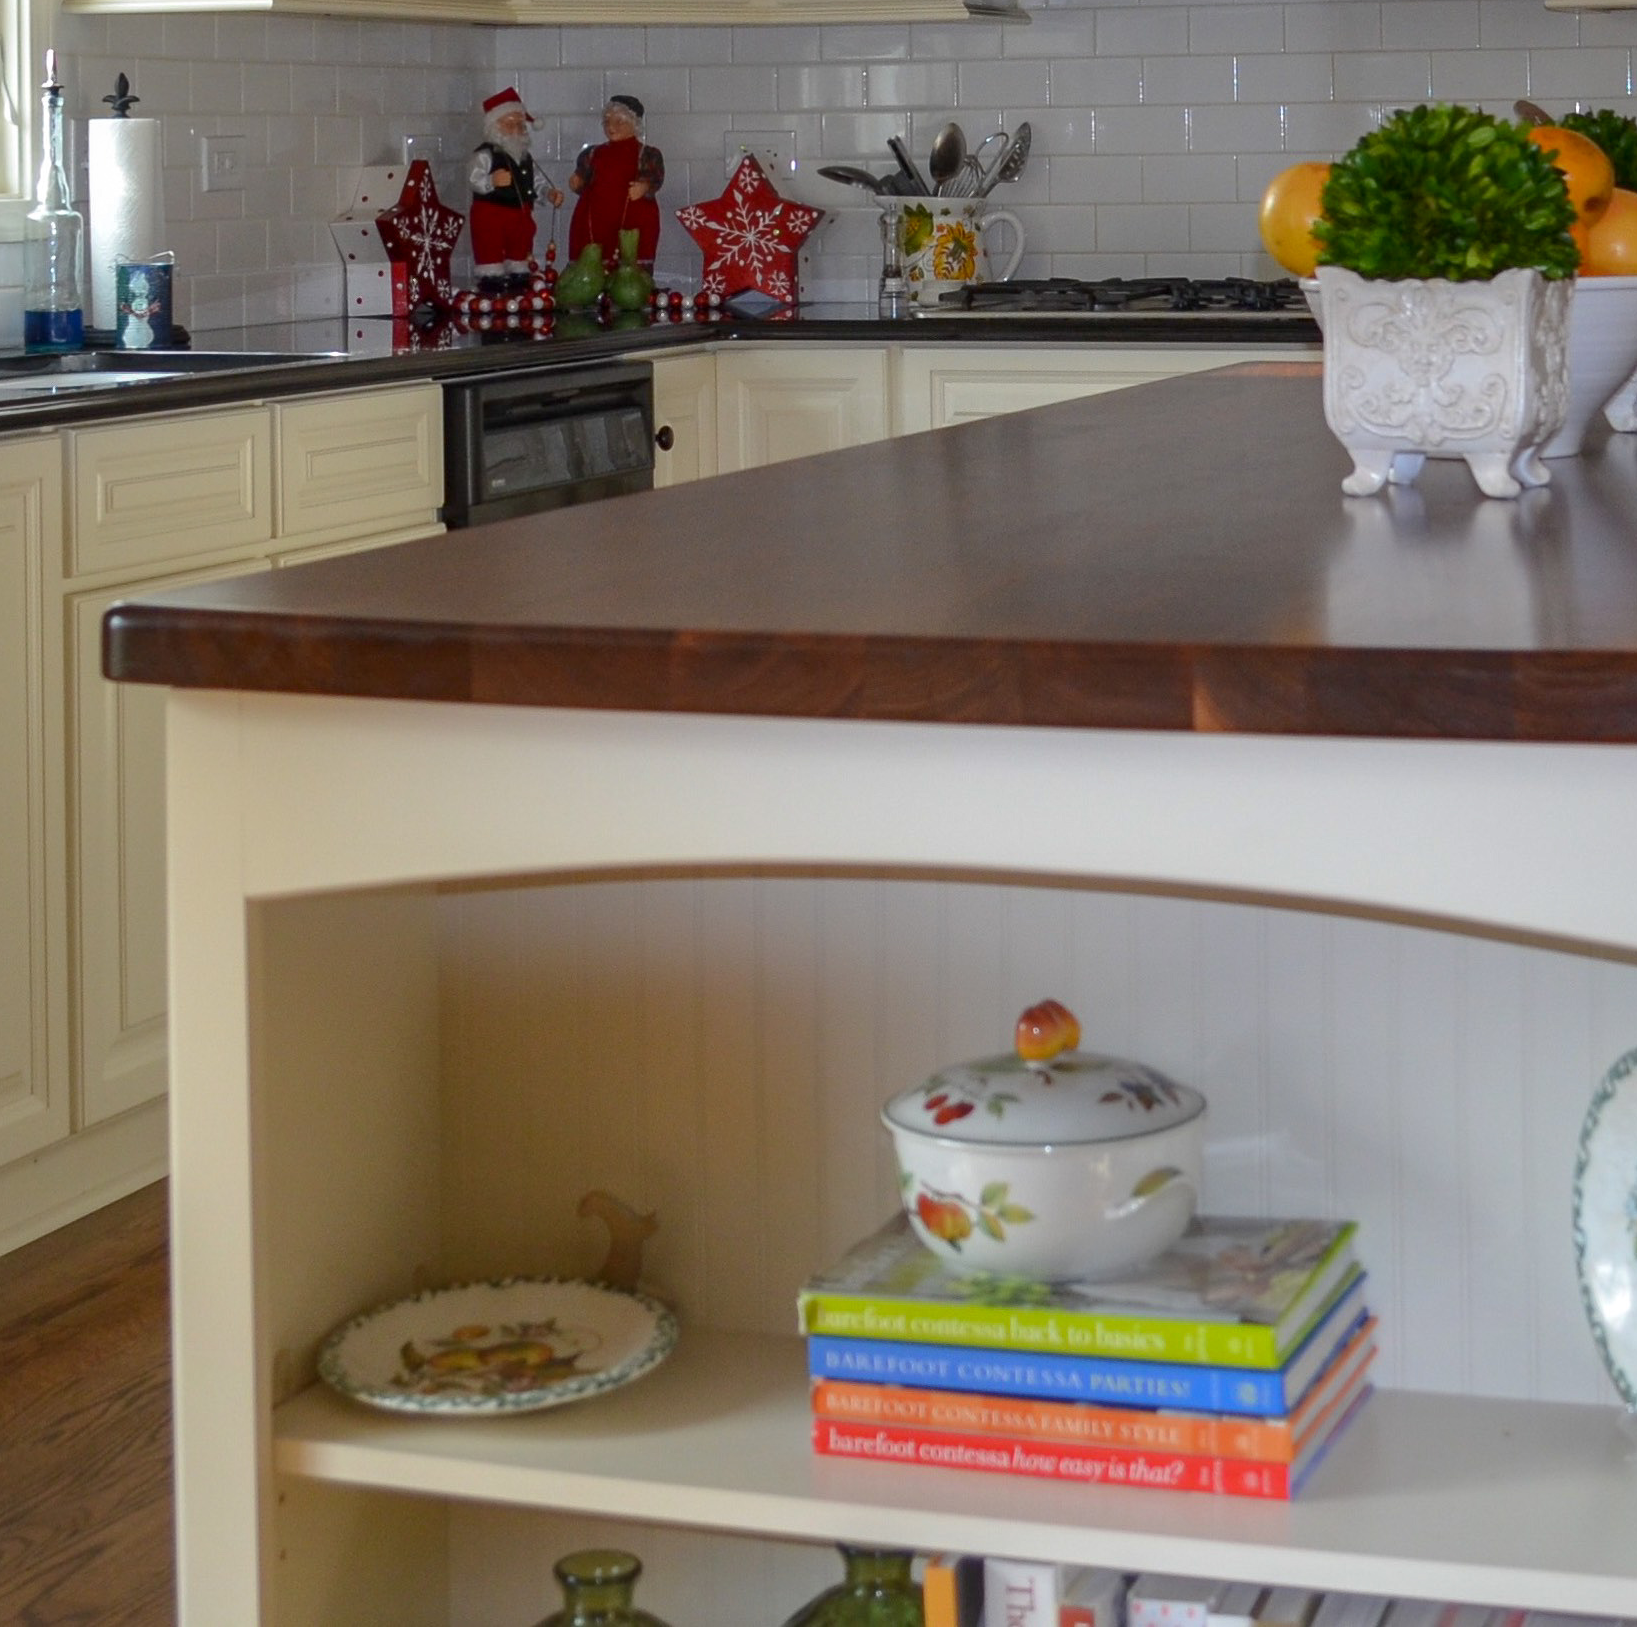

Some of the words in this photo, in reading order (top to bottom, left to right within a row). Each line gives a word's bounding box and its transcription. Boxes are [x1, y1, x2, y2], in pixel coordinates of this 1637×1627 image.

[819, 1305, 906, 1333] barefoot
[911, 1315, 1005, 1339] contessa
[1010, 1315, 1063, 1343] back
[1067, 1325, 1090, 1345] to
[1095, 1320, 1165, 1350] basics
[825, 1350, 948, 1378] BAREFOOT
[957, 1362, 1083, 1390] CONTESSA
[825, 1392, 927, 1419] BAREFOOT
[932, 1405, 1036, 1429] CONTESSA
[1040, 1412, 1114, 1438] FAMILY
[1119, 1419, 1182, 1444] STYLE
[828, 1426, 915, 1458] barefoot
[919, 1439, 1010, 1467] contessa
[1012, 1444, 1059, 1472] how
[1059, 1455, 1103, 1484] easy
[1107, 1454, 1128, 1479] is
[1128, 1454, 1185, 1485] that?
